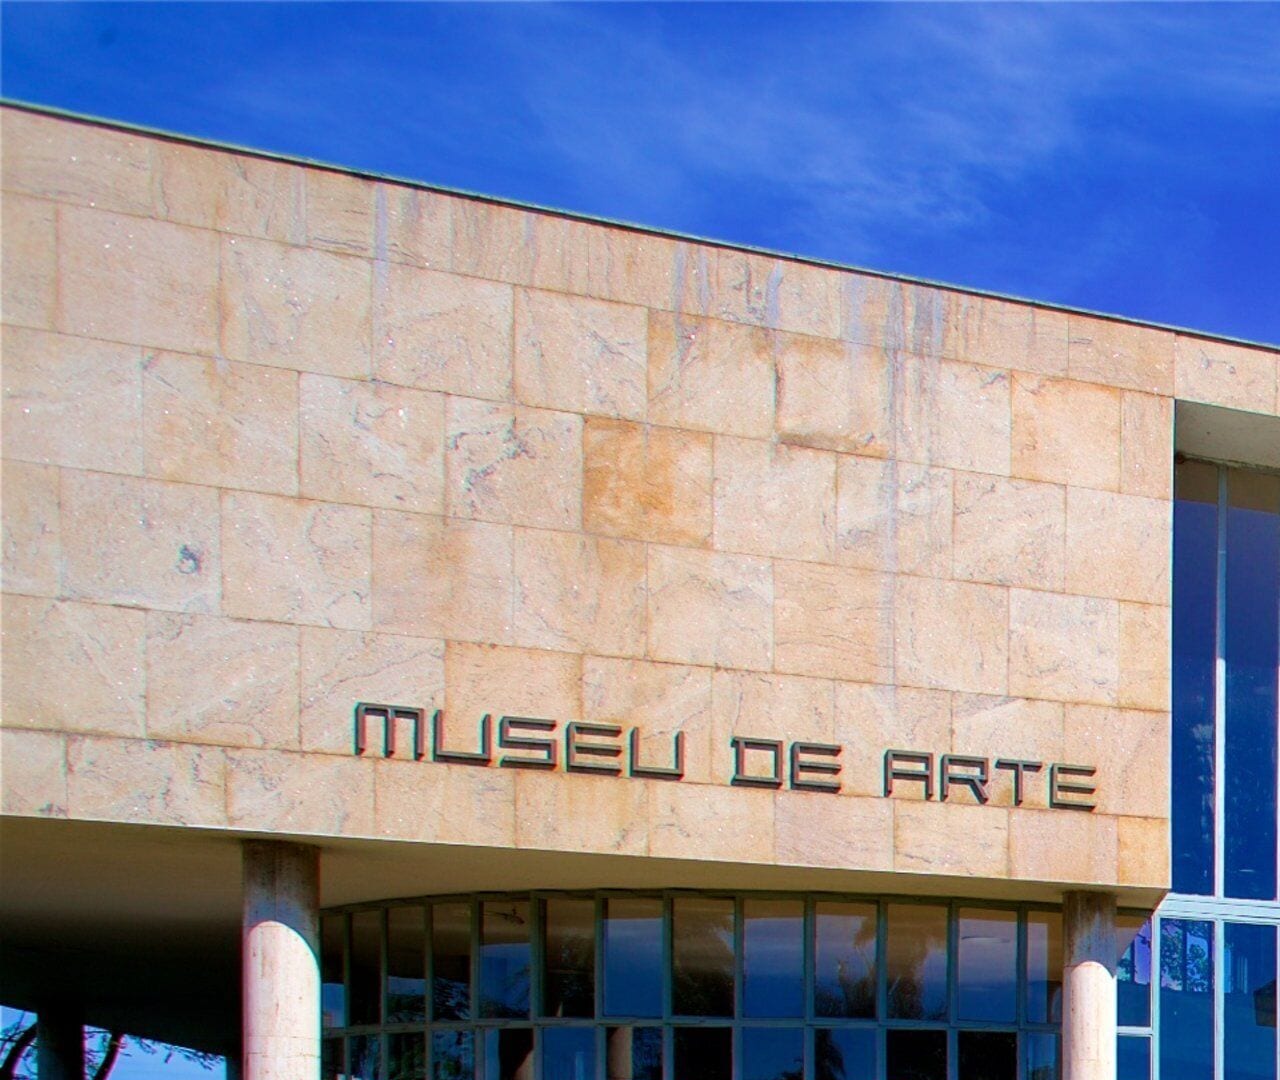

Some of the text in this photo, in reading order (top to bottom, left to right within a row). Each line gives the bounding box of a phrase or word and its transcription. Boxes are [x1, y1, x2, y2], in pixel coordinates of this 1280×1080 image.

[353, 701, 1097, 813] MUSEU DE ARTE
